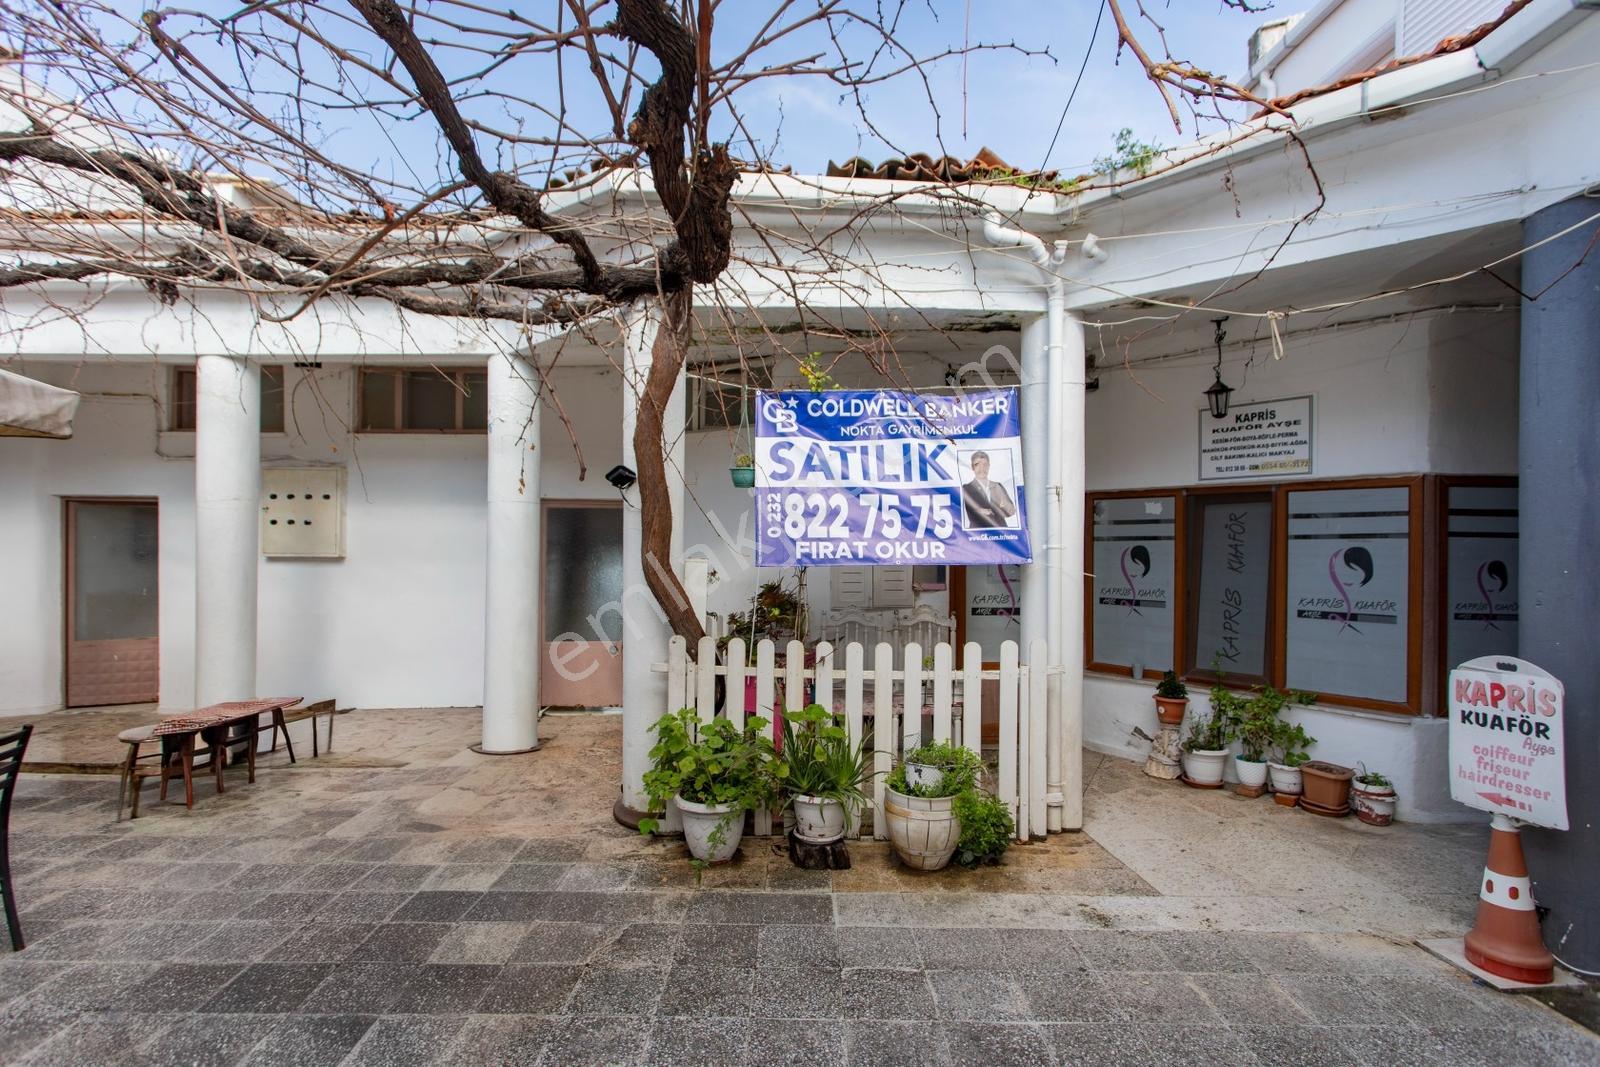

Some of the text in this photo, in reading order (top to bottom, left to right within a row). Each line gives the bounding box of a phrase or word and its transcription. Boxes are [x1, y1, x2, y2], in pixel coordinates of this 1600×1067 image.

[807, 397, 1009, 418] COLDWELL BANKER
[1235, 408, 1276, 424] KAPRİS
[840, 423, 978, 437] NOKTA GAYRİMENKUL
[1267, 419, 1302, 429] AYŞE
[768, 440, 954, 483] SATILIK
[766, 492, 782, 538] 0 232
[784, 493, 850, 539] 822
[860, 493, 901, 539] 75
[911, 493, 954, 540] 75
[796, 541, 946, 559] FIRAT OKUR
[1220, 511, 1248, 663] KAPRİS KUAFÖR
[1297, 597, 1397, 612] KAPRİS KUAFÖR
[1455, 678, 1556, 718] KAPRİS
[1460, 710, 1550, 740] KUAFÖR
[1473, 744, 1535, 767] coiffeur
[1476, 756, 1530, 781] friseur
[1458, 764, 1552, 801] hairdresser
